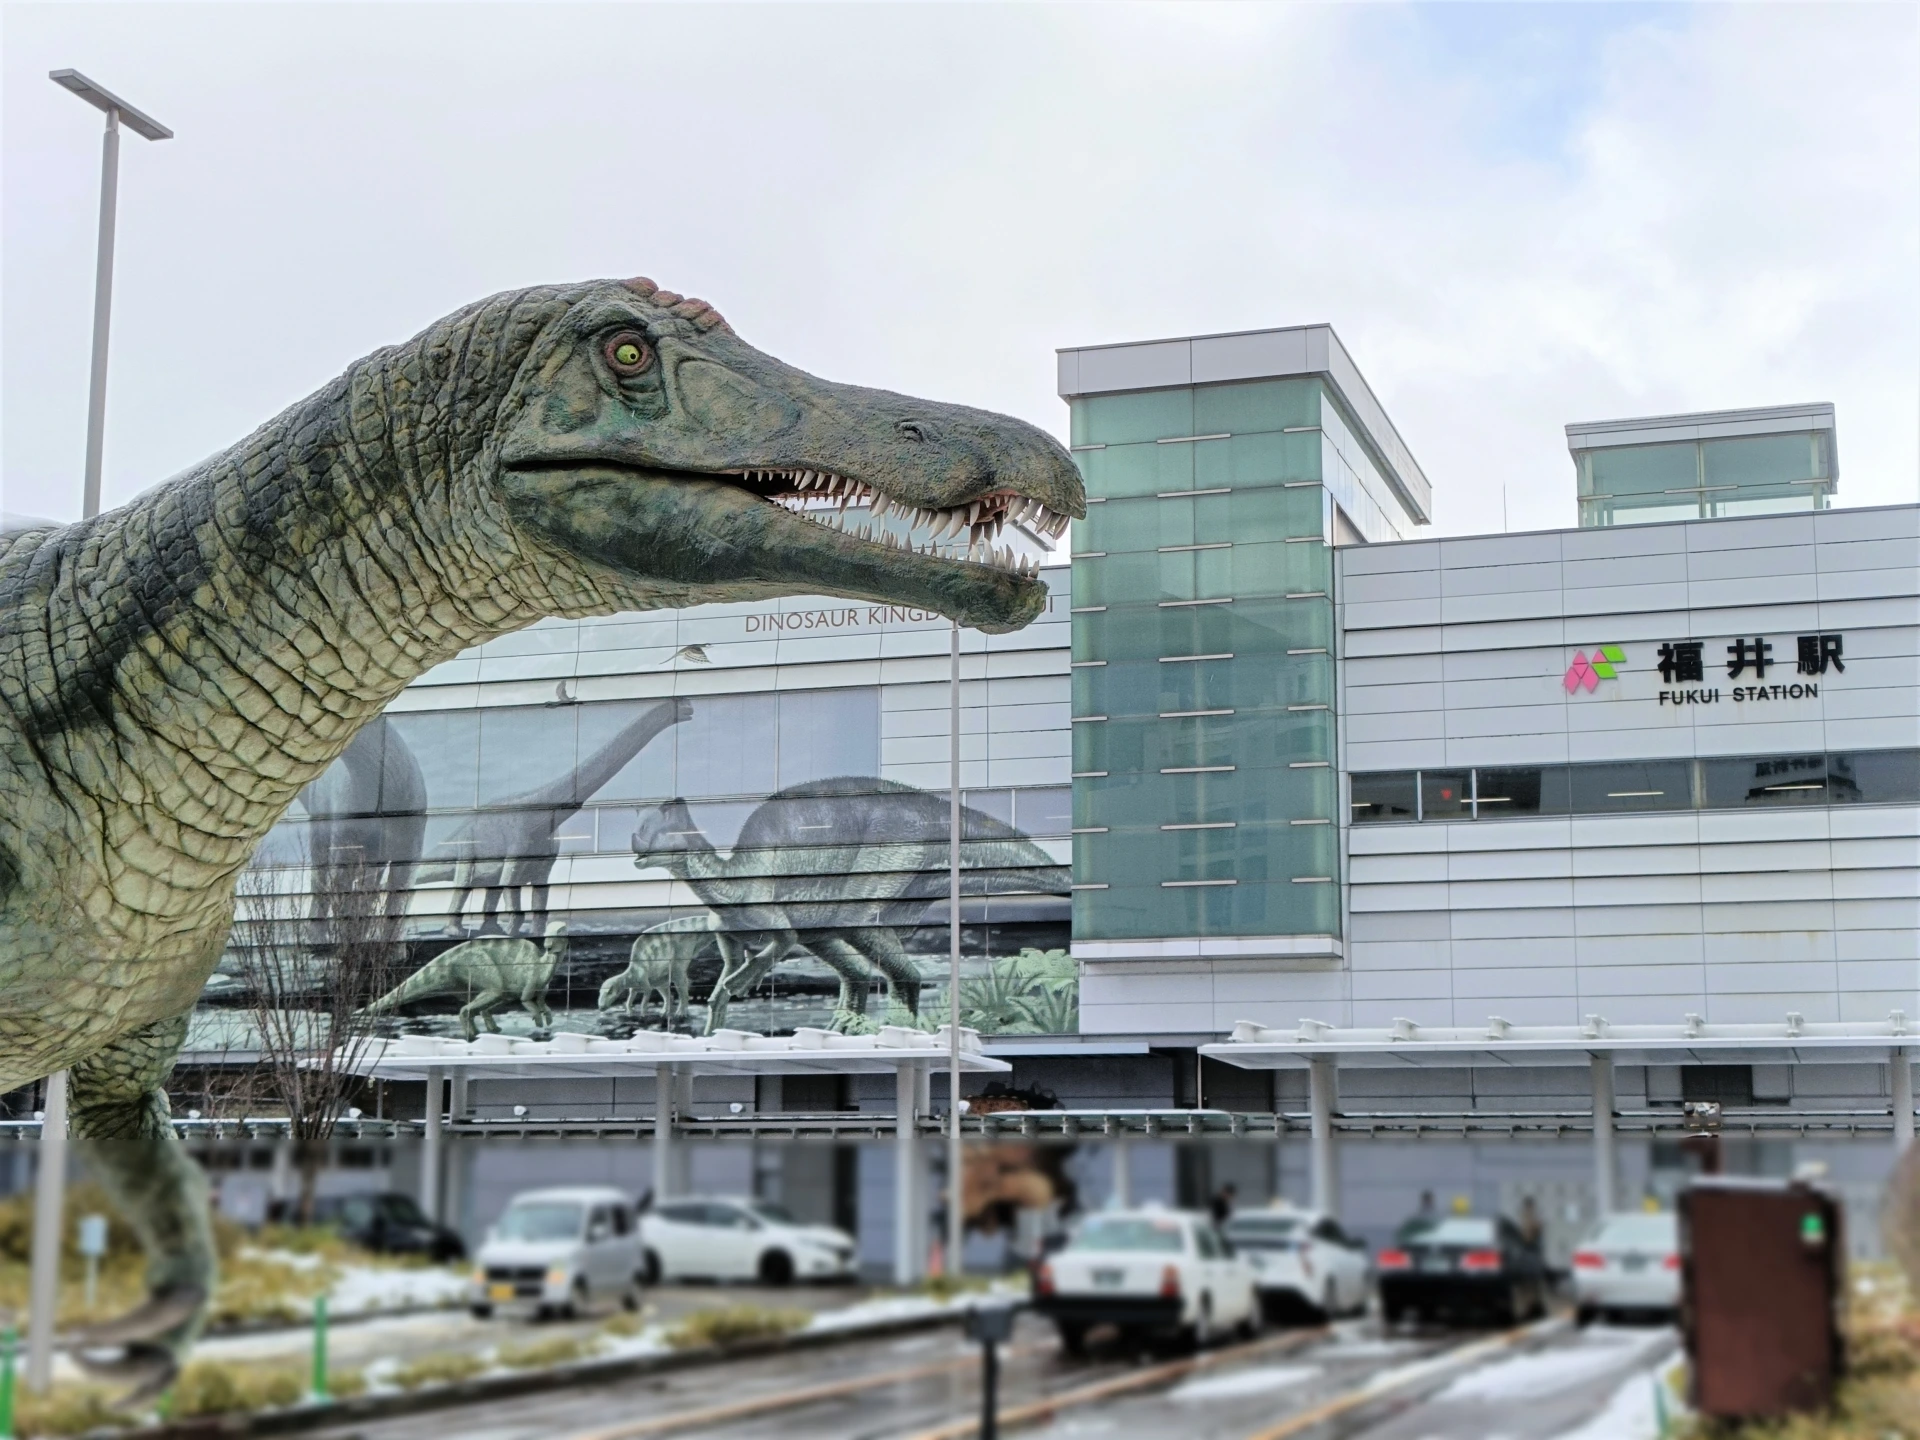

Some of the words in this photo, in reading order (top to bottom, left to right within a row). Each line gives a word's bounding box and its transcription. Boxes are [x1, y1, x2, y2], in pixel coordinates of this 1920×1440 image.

[745, 609, 860, 633] DINOSAUR
[868, 606, 941, 625] KINGD
[1657, 634, 1846, 684] 福井駅
[1658, 688, 1719, 706] FUKUI
[1732, 683, 1819, 702] STATION
